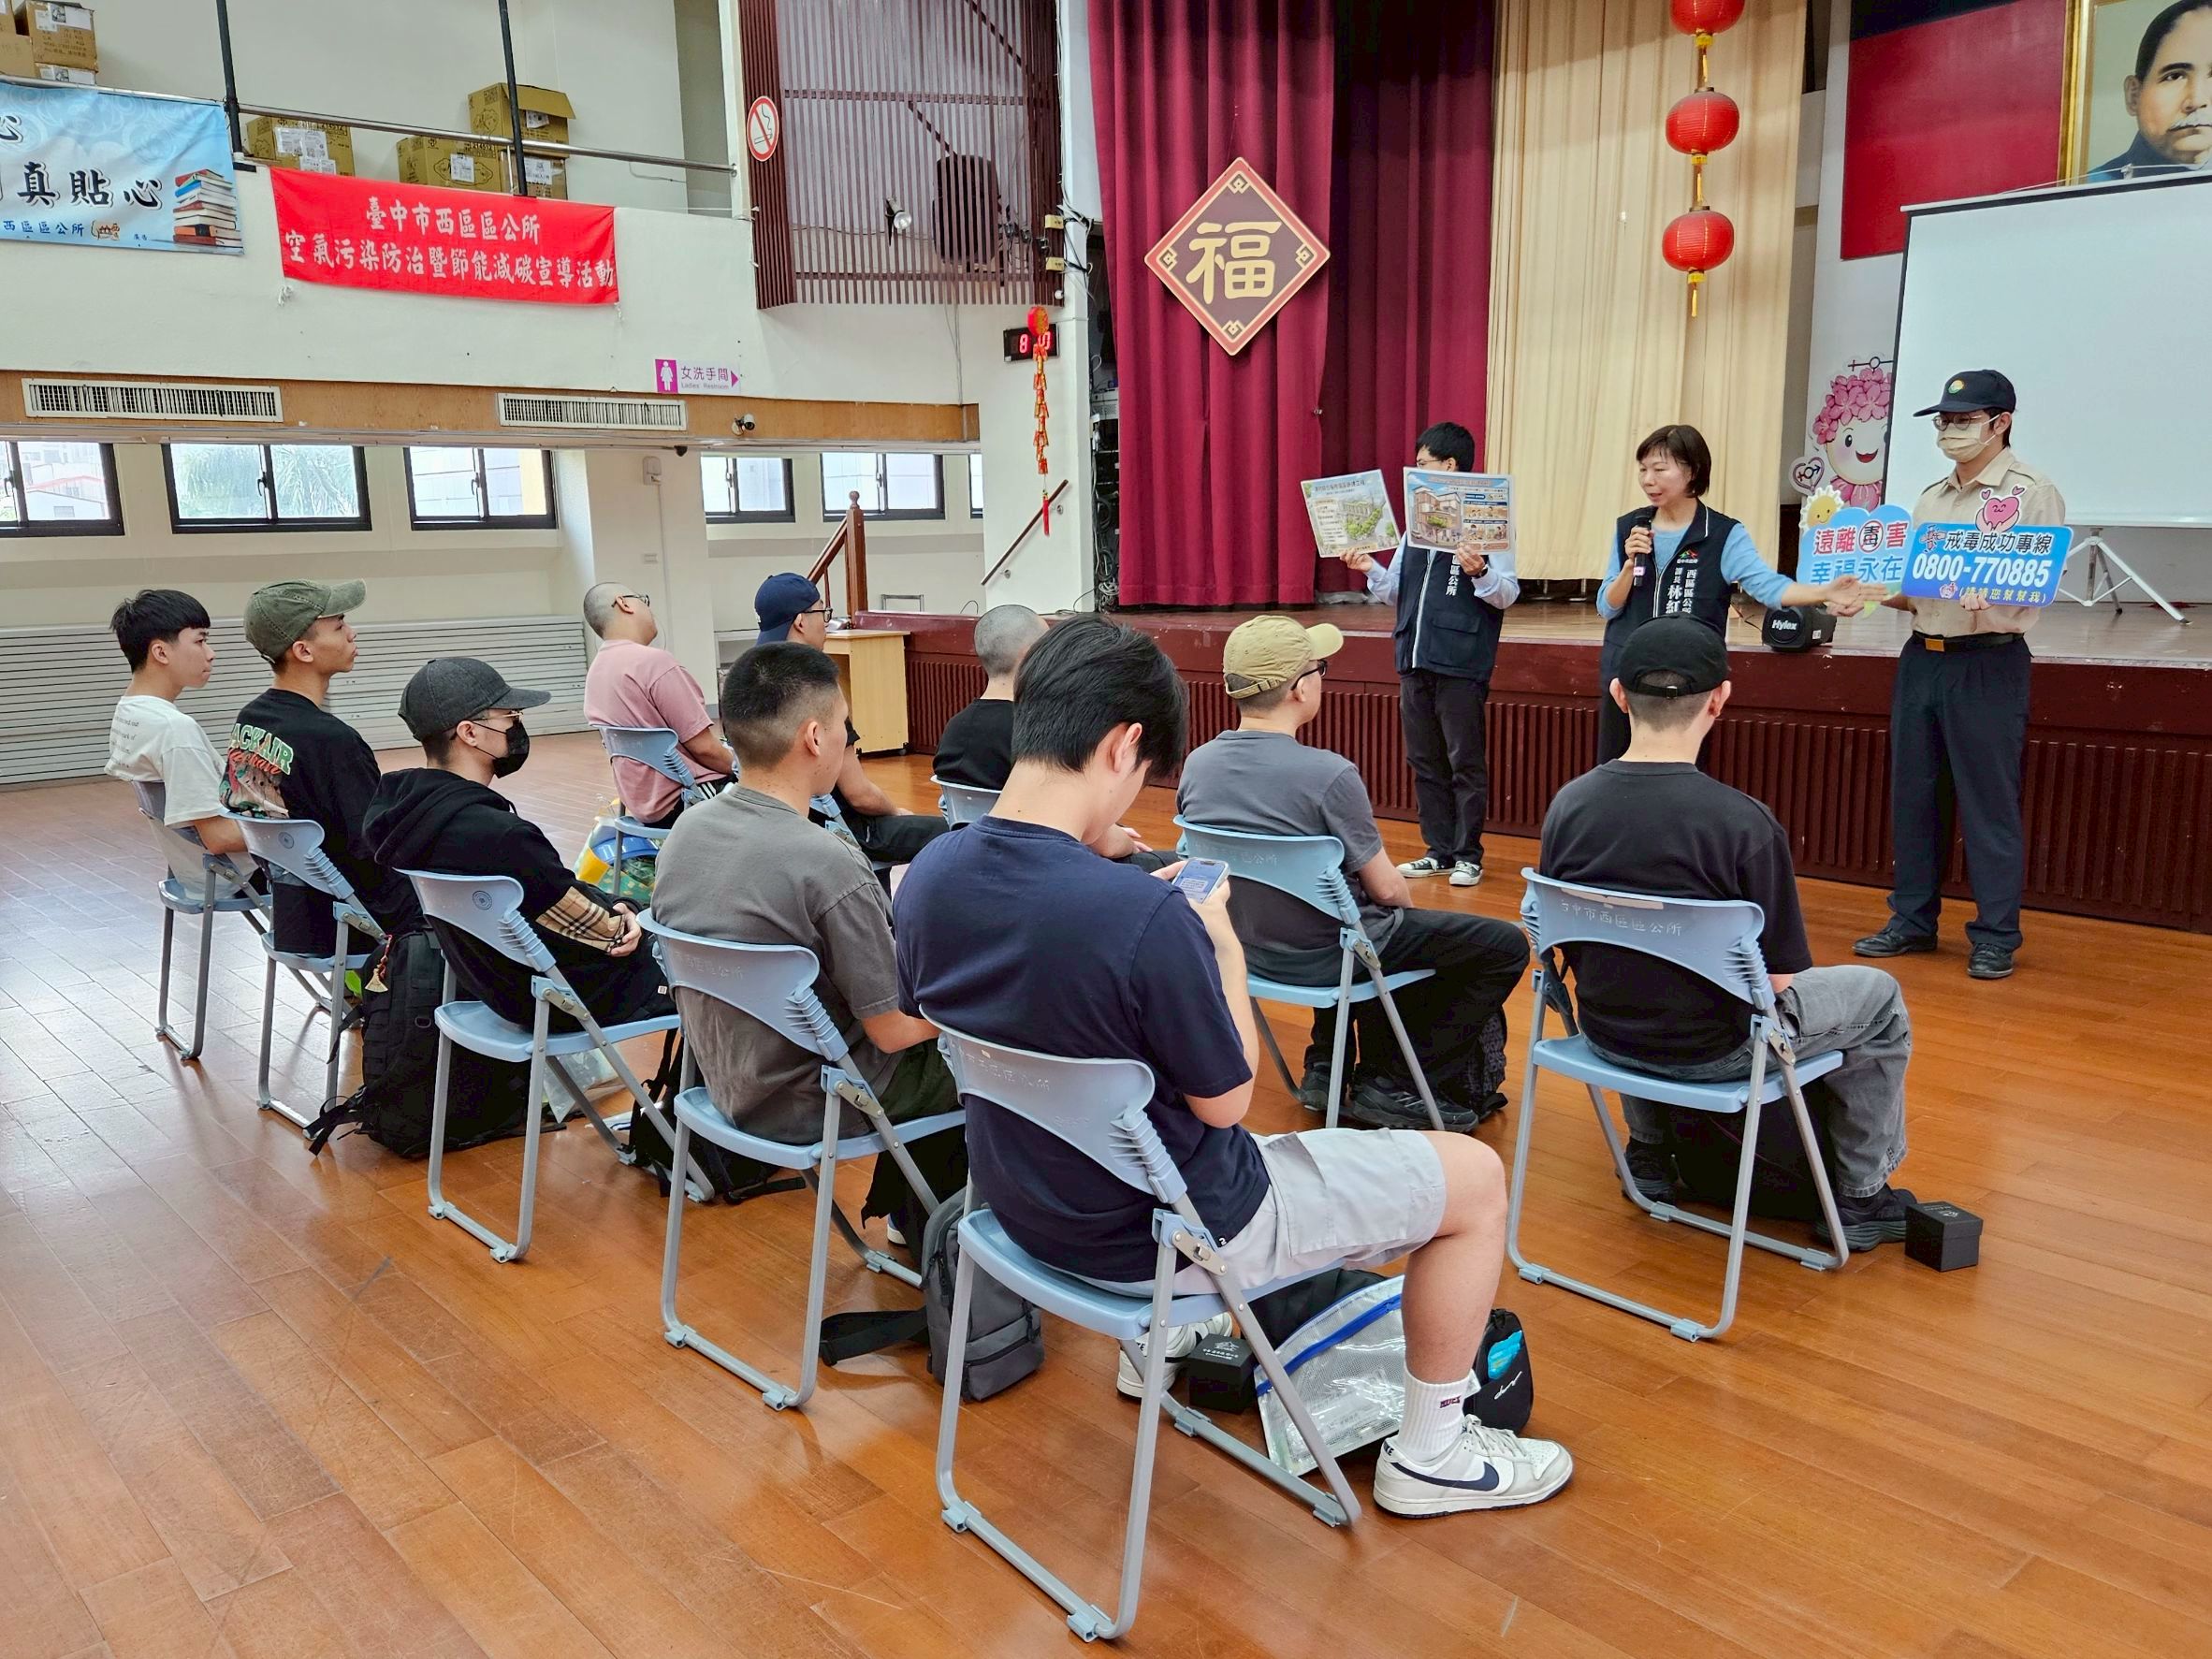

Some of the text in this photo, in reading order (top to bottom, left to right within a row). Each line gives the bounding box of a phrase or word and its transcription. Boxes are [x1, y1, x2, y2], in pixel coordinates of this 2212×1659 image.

[366, 196, 540, 245] 臺中市西區區公所
[284, 229, 615, 289] 空氣污染防治暨節能減碳宣導活動
[1186, 221, 1282, 305] 福
[680, 366, 729, 382] 女洗手間
[1812, 521, 1909, 556] 遠離毒害
[1944, 530, 2054, 555] 戒毒成功專線
[1911, 552, 2053, 589] 0800-770885
[1771, 618, 1798, 631] Hylex
